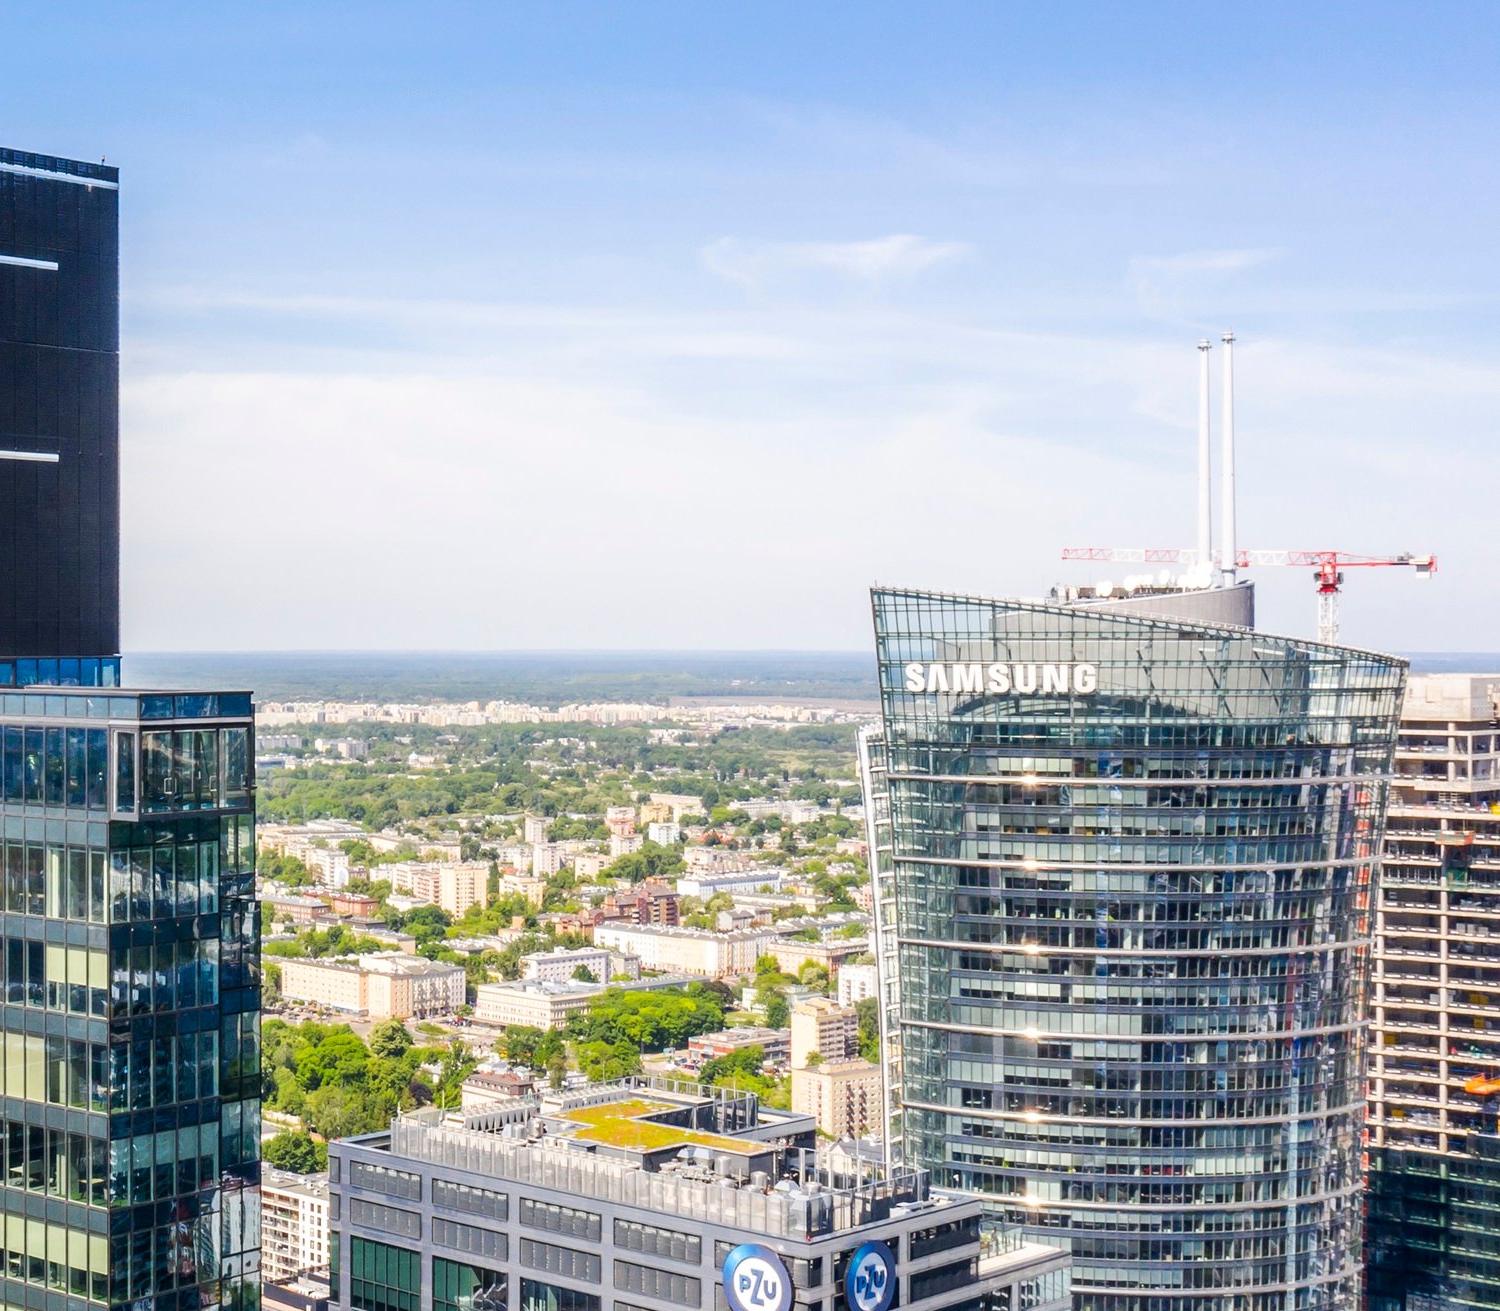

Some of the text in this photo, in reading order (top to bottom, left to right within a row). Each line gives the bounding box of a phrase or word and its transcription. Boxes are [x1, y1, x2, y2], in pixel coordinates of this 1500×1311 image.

[905, 663, 1096, 693] SAMSUNG
[739, 1268, 777, 1307] PZU
[856, 1263, 886, 1301] PZU
